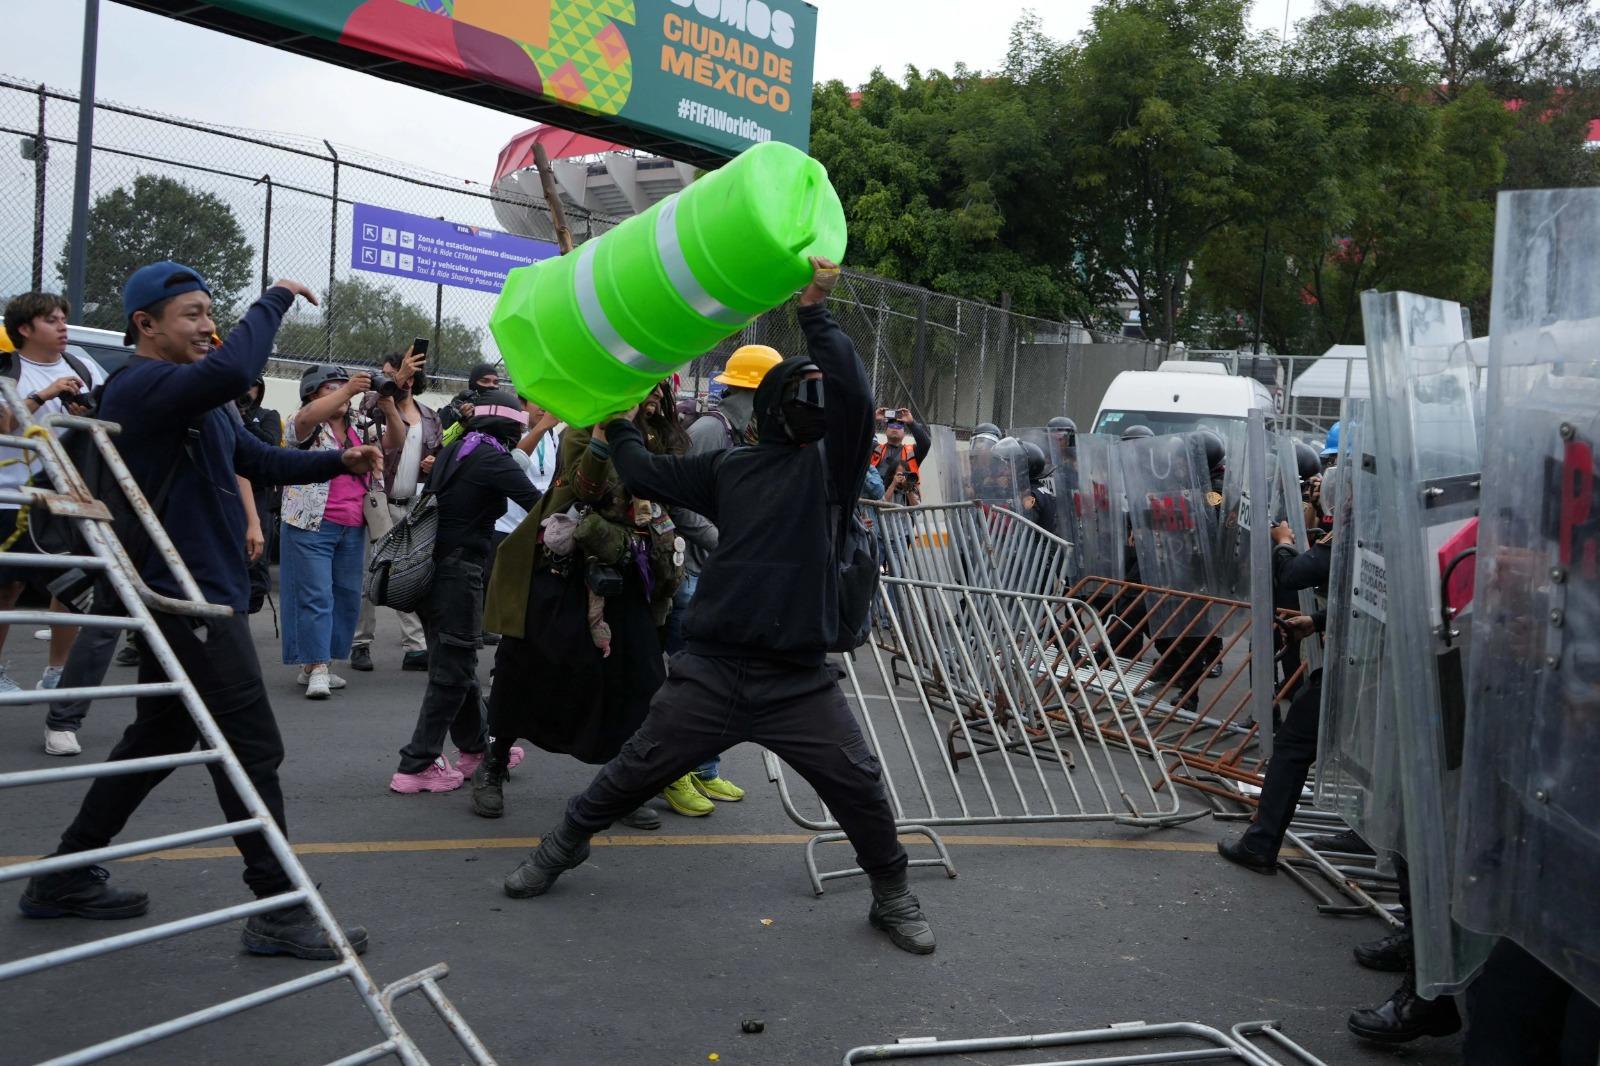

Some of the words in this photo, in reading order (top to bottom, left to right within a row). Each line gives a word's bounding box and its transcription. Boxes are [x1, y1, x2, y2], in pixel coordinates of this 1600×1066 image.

[669, 0, 796, 49] MOS
[663, 12, 760, 71] CIUDAD
[762, 50, 793, 84] DE
[660, 44, 791, 112] MÉXICO
[677, 98, 772, 142] #FIFAWorldCup
[417, 234, 435, 244] Zona
[436, 238, 445, 246] de
[445, 241, 499, 257] estacionamiento
[500, 252, 532, 264] disuasorio
[417, 256, 431, 265] Taxi
[470, 268, 507, 279] compartido
[418, 244, 432, 253] Park
[439, 249, 453, 257] Ride
[454, 251, 478, 262] CETRAM
[417, 266, 429, 274] Taxi
[437, 270, 450, 278] Ride
[451, 272, 474, 284] Sharing
[475, 277, 493, 286] Paseo
